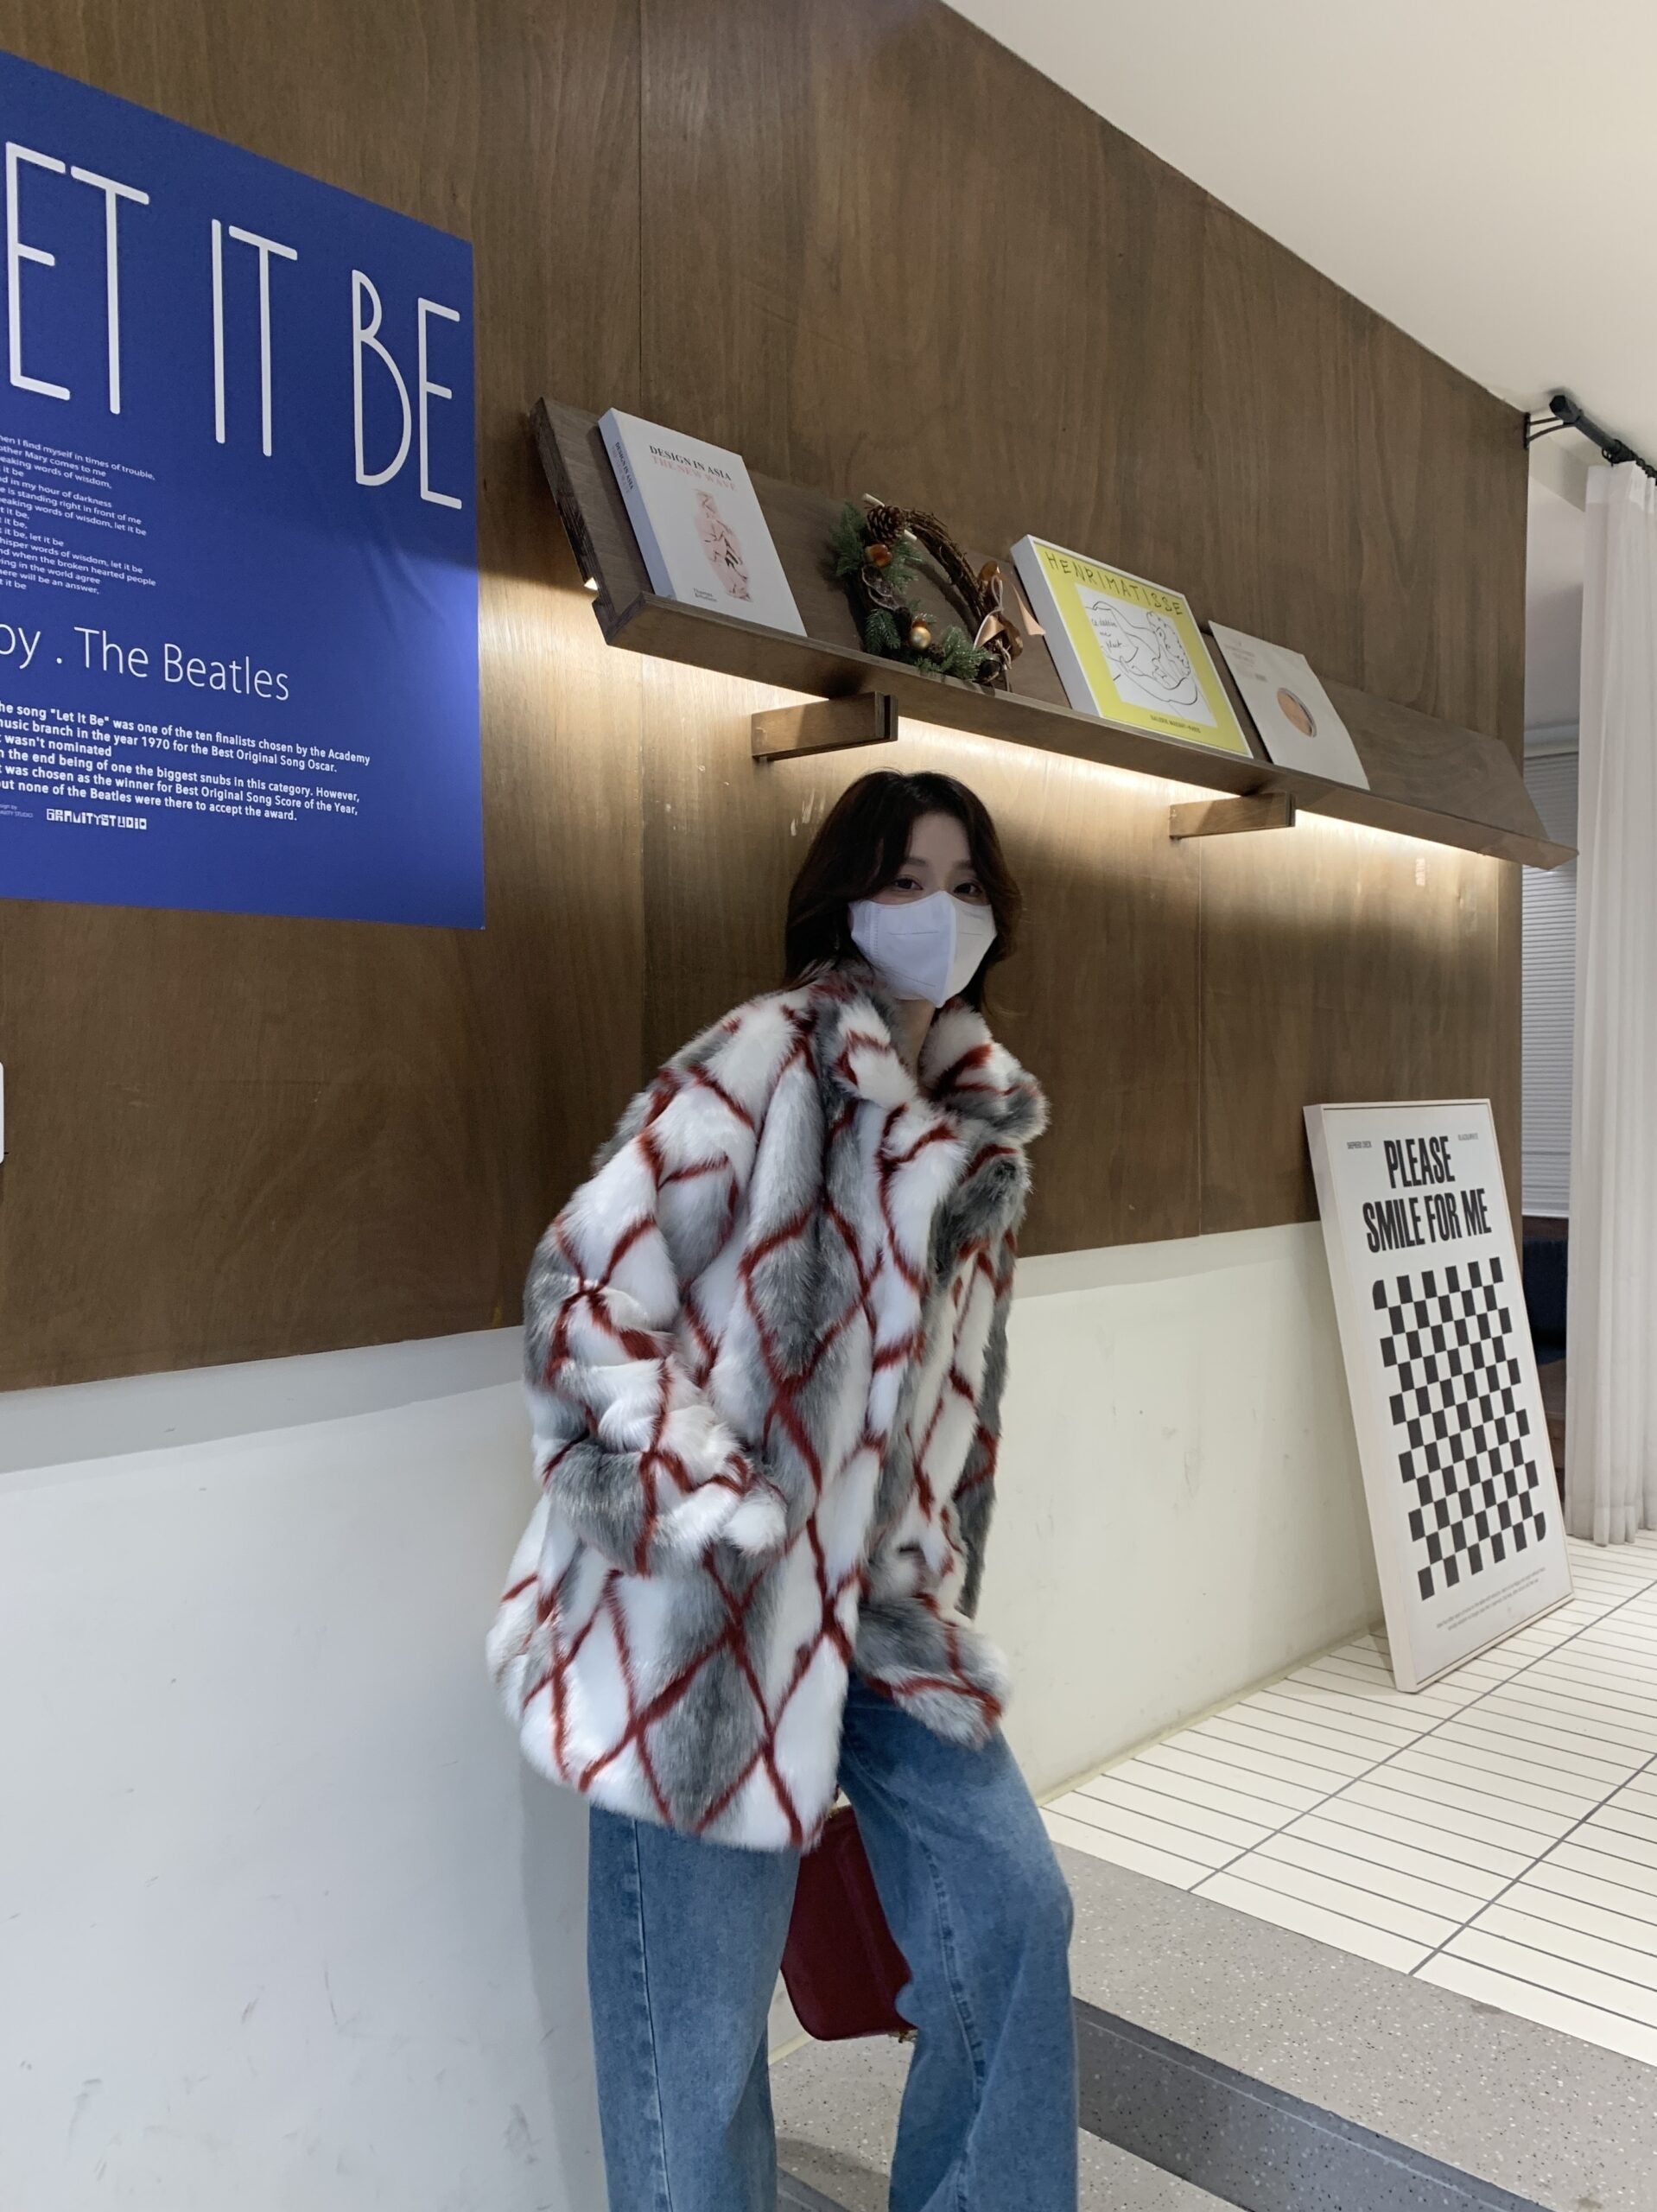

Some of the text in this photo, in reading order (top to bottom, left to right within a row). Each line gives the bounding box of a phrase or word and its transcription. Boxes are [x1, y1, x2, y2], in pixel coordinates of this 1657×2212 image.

[6, 141, 462, 510] ET IT BE
[22, 440, 41, 450] find
[43, 447, 73, 458] myself
[86, 457, 109, 467] times
[25, 451, 48, 463] Mary
[50, 459, 79, 470] comes
[34, 465, 61, 475] words
[649, 445, 733, 481] DESIGN IN ASIA
[12, 467, 23, 477] be
[17, 491, 58, 506] standing
[60, 501, 80, 510] right
[94, 507, 115, 518] front
[22, 482, 36, 491] my
[39, 485, 60, 495] hour
[73, 493, 111, 507] darkness
[0, 498, 33, 511] eaking
[35, 505, 62, 516] words
[115, 522, 125, 531] let
[136, 527, 146, 536] be
[30, 533, 41, 542] let
[12, 551, 156, 586] when the broken hearted people
[30, 545, 59, 556] words
[132, 565, 143, 574] be
[30, 564, 45, 573] the
[48, 569, 73, 578] world
[75, 575, 100, 584] agree
[15, 581, 26, 589] be
[74, 626, 149, 677] The
[164, 644, 289, 701] Beatles
[4, 735, 111, 756] wasn't nominated
[17, 706, 46, 721] song
[51, 709, 74, 722] "Let
[78, 713, 86, 724] It
[90, 715, 109, 726] Be"
[113, 721, 134, 730] was
[137, 723, 158, 734] one
[162, 725, 172, 735] of
[175, 727, 193, 739] the
[195, 731, 212, 741] ten
[216, 732, 256, 747] finalists
[259, 739, 293, 753] chosen
[296, 744, 308, 757] by
[310, 747, 326, 757] the
[328, 749, 370, 766] Academy
[33, 721, 73, 736] branch
[77, 728, 88, 739] in
[92, 730, 111, 741] the
[114, 734, 138, 745] year
[142, 736, 169, 749] 1970
[173, 741, 188, 752] for
[191, 743, 208, 754] the
[212, 746, 233, 759] Best
[237, 749, 277, 764] Original
[281, 755, 305, 770] Song
[308, 760, 337, 772] Oscar.
[5, 766, 357, 815] was chosen as the winner for Best Original Song Score of the Year,
[8, 749, 359, 803] the end being of one the biggest snubs in this category. However,
[18, 782, 48, 793] none
[53, 785, 64, 795] of
[67, 786, 86, 798] the
[91, 788, 131, 803] Beatles
[135, 796, 162, 805] were
[164, 797, 193, 809] there
[195, 801, 206, 810] to
[209, 804, 242, 816] accept
[244, 805, 261, 817] the
[264, 810, 296, 820] award.
[1384, 1135, 1456, 1189] PLEASE
[1362, 1187, 1492, 1254] SMILE FOR ME
